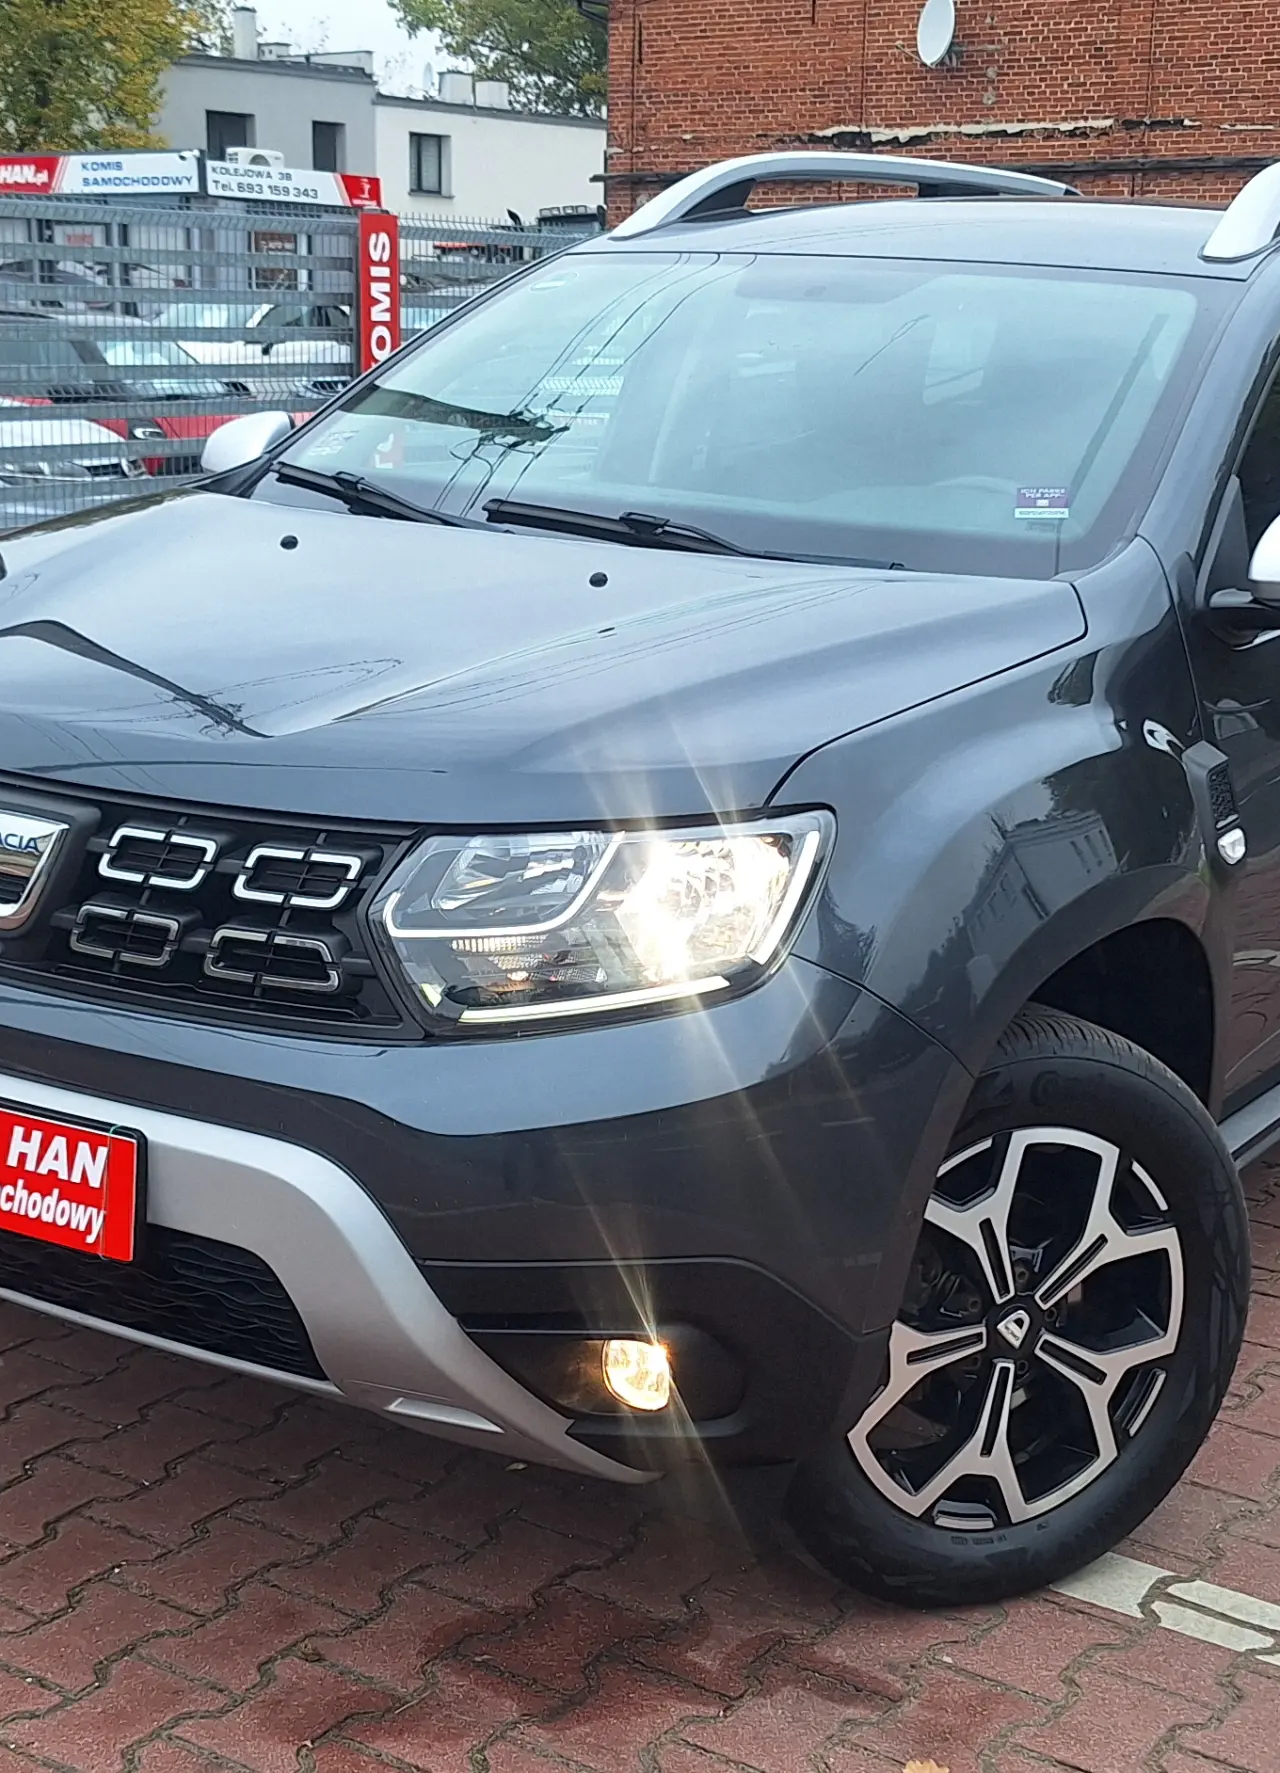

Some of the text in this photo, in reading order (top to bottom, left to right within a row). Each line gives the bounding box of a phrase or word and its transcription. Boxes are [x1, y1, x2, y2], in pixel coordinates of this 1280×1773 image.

[81, 161, 124, 172] KOMIS
[211, 166, 273, 181] KOLEJOWA
[81, 176, 194, 188] SAMOCHODOWY
[237, 182, 264, 195] 693
[268, 185, 291, 197] 159
[293, 187, 319, 200] 343
[369, 231, 392, 367] OMIS
[6, 1125, 108, 1188] HAN
